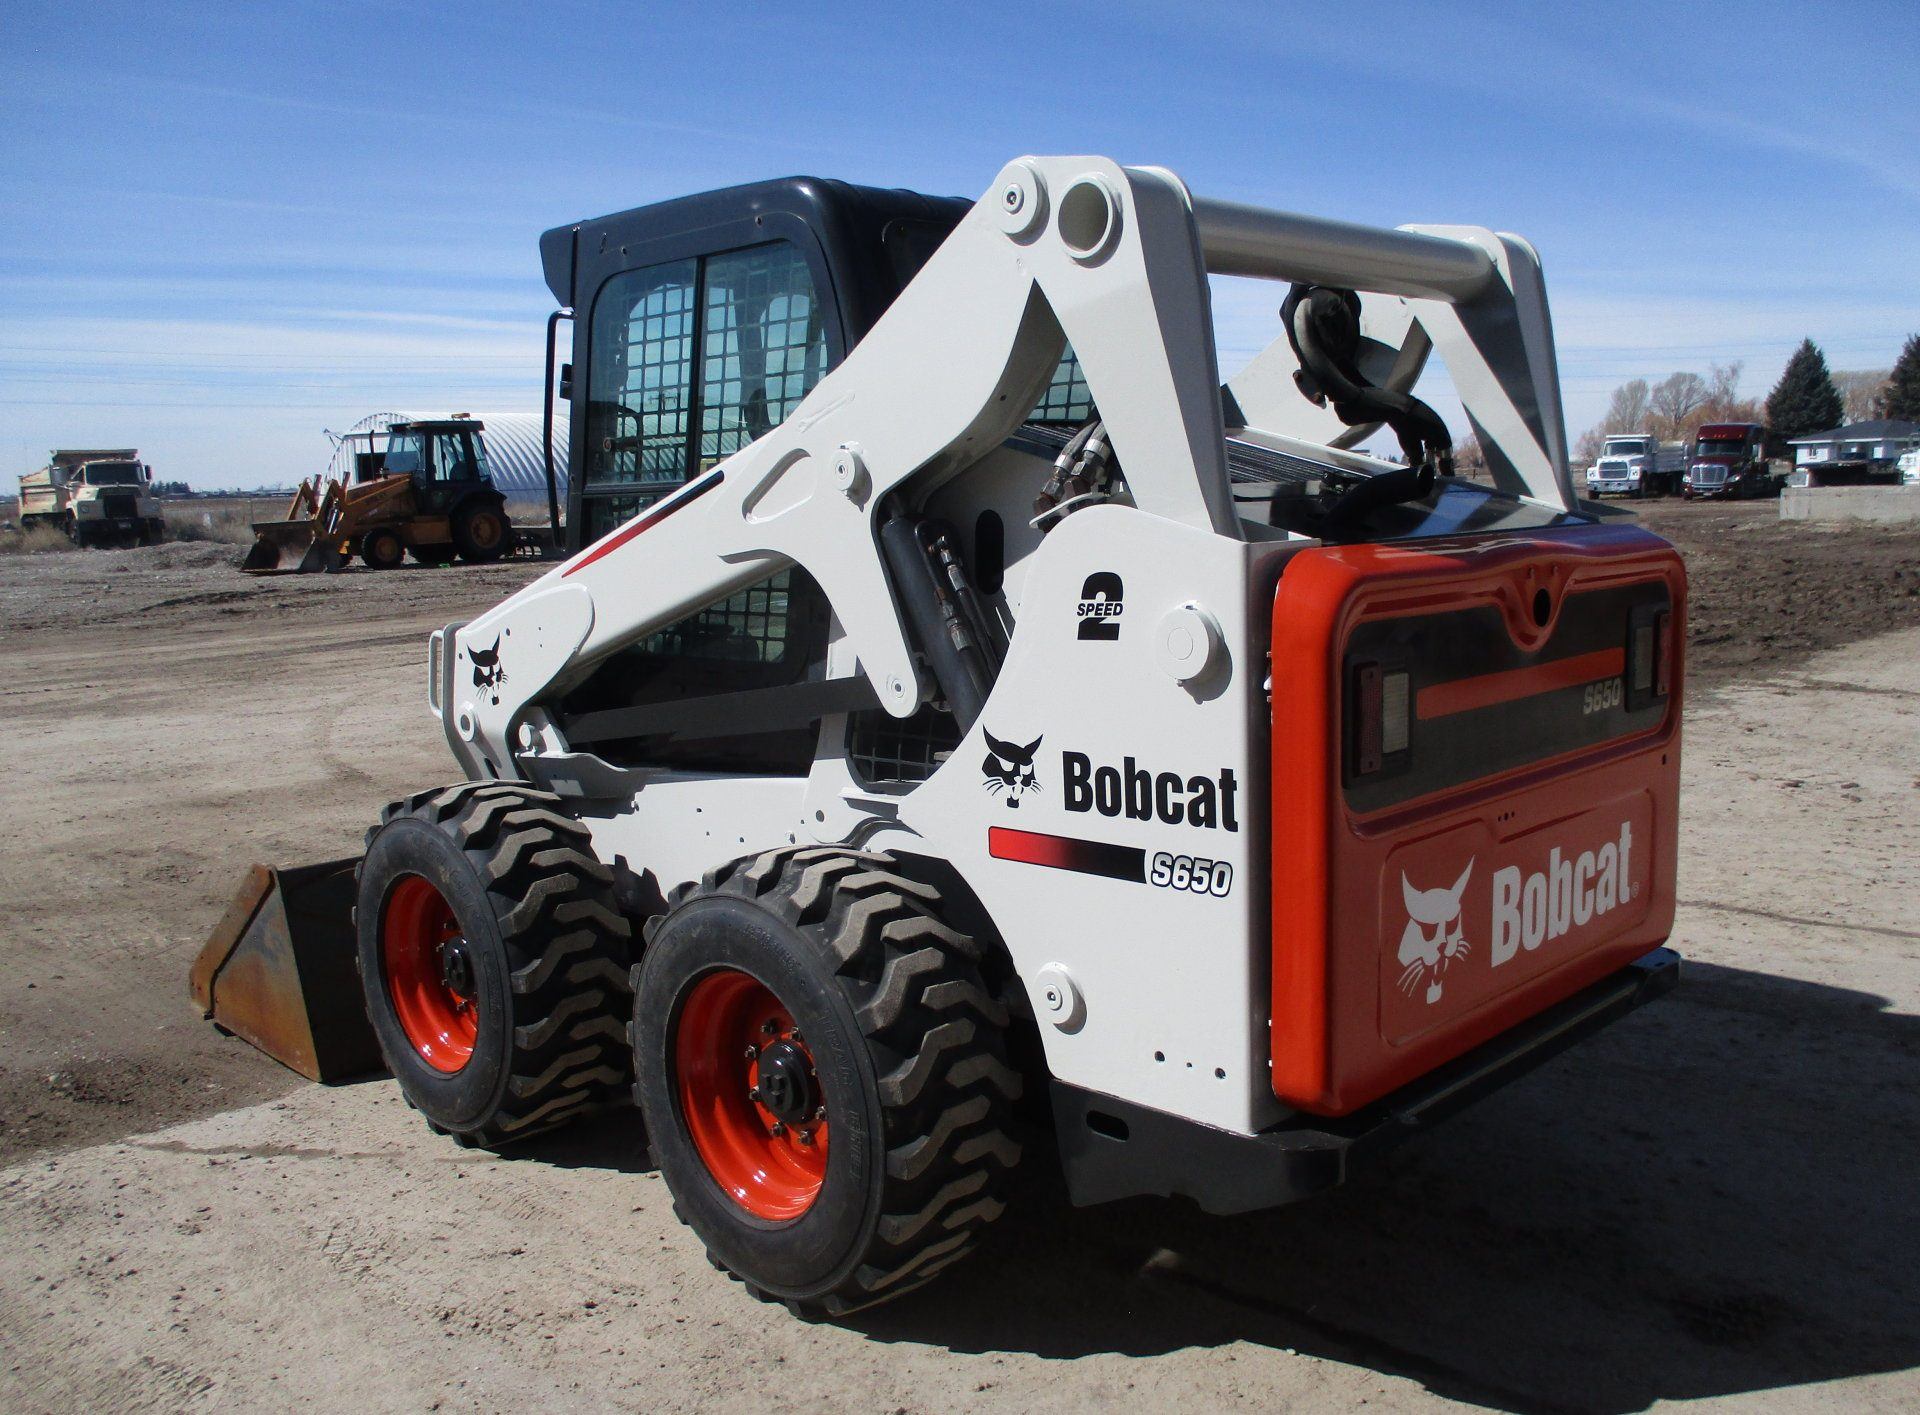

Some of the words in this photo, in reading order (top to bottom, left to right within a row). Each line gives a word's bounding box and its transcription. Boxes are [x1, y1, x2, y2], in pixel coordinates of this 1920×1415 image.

[1077, 572, 1123, 640] 2
[1077, 603, 1123, 616] SPEED
[1584, 678, 1621, 714] S650
[1062, 751, 1238, 832] Bobcat
[1150, 852, 1233, 897] S650
[1491, 821, 1631, 968] Bobcat
